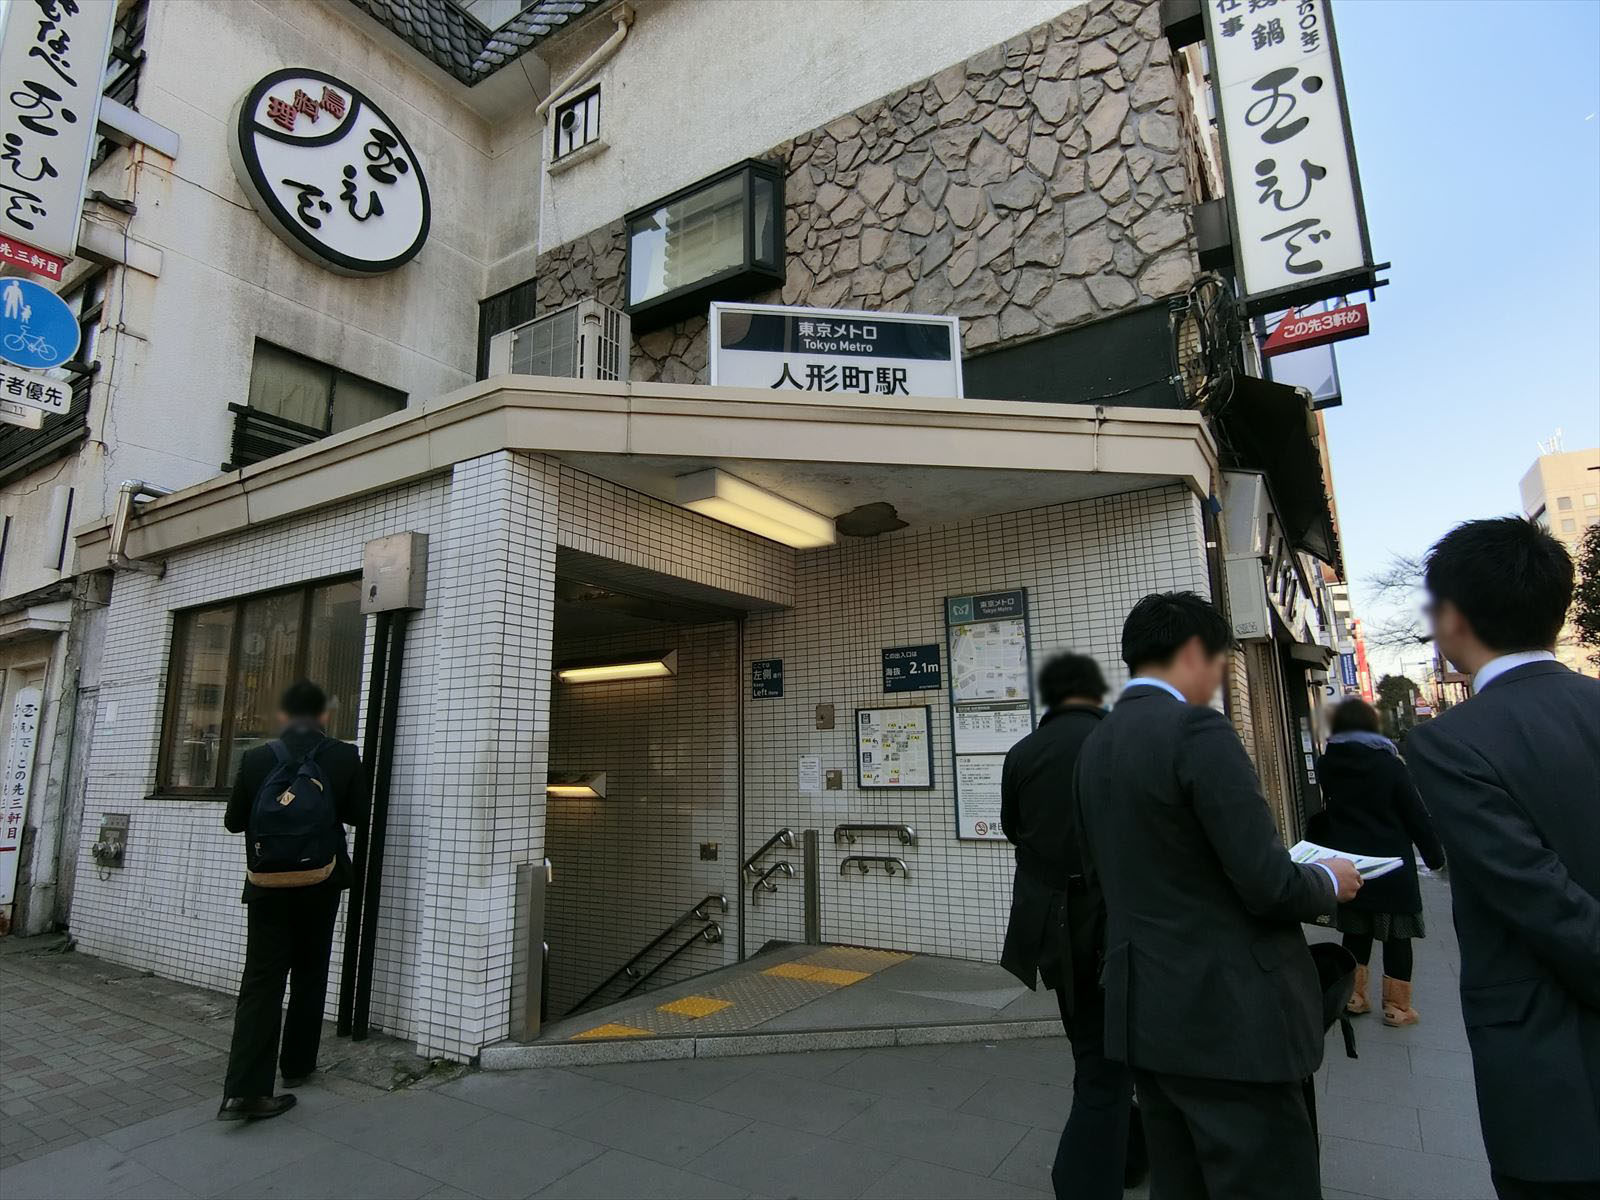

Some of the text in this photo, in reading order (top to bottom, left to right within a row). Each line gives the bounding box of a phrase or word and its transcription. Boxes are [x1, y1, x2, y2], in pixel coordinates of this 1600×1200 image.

[798, 321, 877, 340] 東京メトロ
[1283, 309, 1361, 339] この先3軒め
[803, 338, 873, 353] Tokyo Metro
[770, 362, 910, 396] 人形町駅
[909, 661, 939, 674] 2.1m
[753, 688, 768, 697] Left
